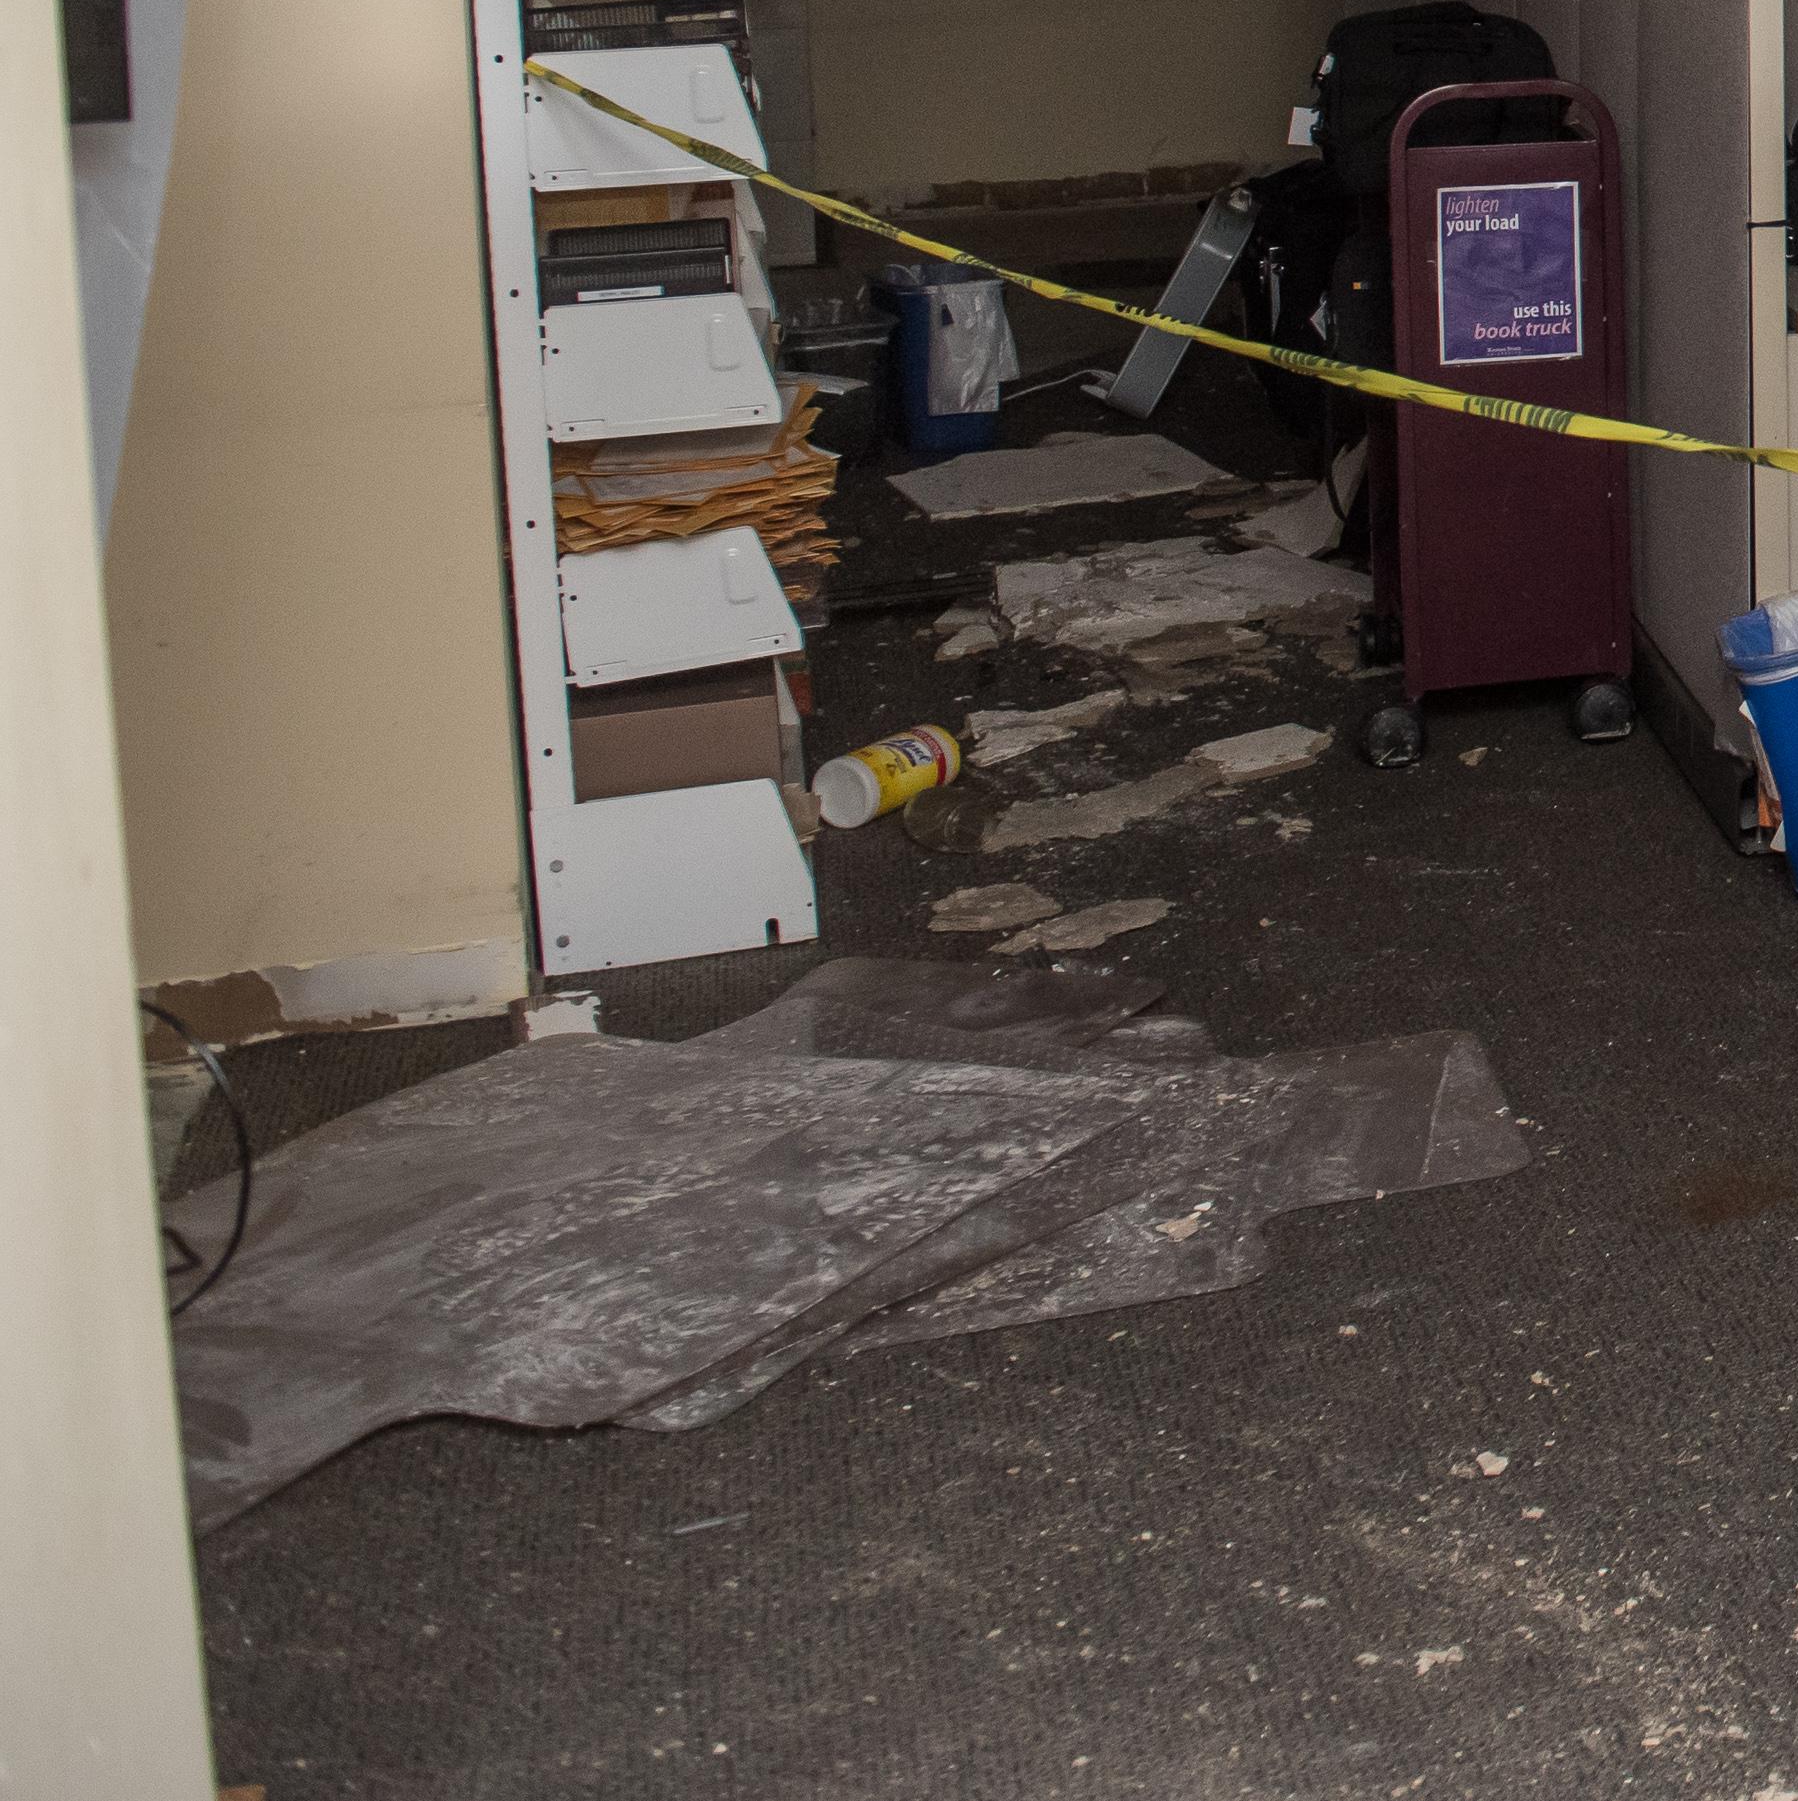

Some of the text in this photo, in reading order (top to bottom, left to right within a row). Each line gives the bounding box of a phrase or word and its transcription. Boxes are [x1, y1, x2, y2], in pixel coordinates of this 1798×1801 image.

[1446, 196, 1500, 219] lighten
[1446, 213, 1520, 236] your load
[1513, 300, 1572, 319] use this
[1472, 318, 1572, 340] book truck
